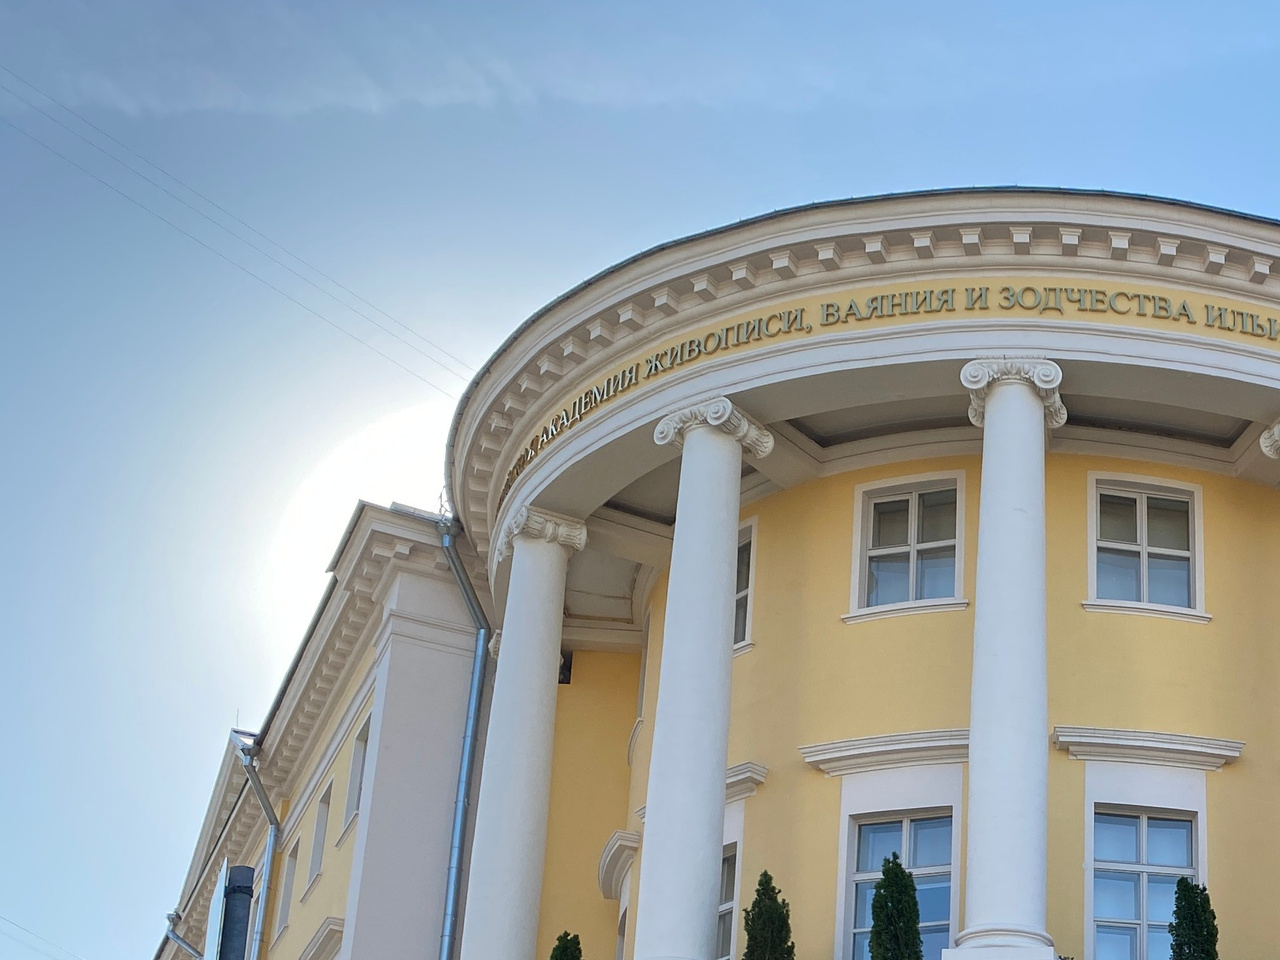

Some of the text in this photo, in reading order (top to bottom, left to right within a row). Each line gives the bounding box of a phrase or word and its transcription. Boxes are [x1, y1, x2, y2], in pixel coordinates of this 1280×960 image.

[538, 363, 640, 450] АКАДЕМИЯ
[643, 307, 812, 380] ЖИВОПИСИ,
[820, 286, 955, 326] ВАЯНИЯ
[964, 286, 990, 311] И
[998, 285, 1197, 325] ЗОДЧЕСТВА
